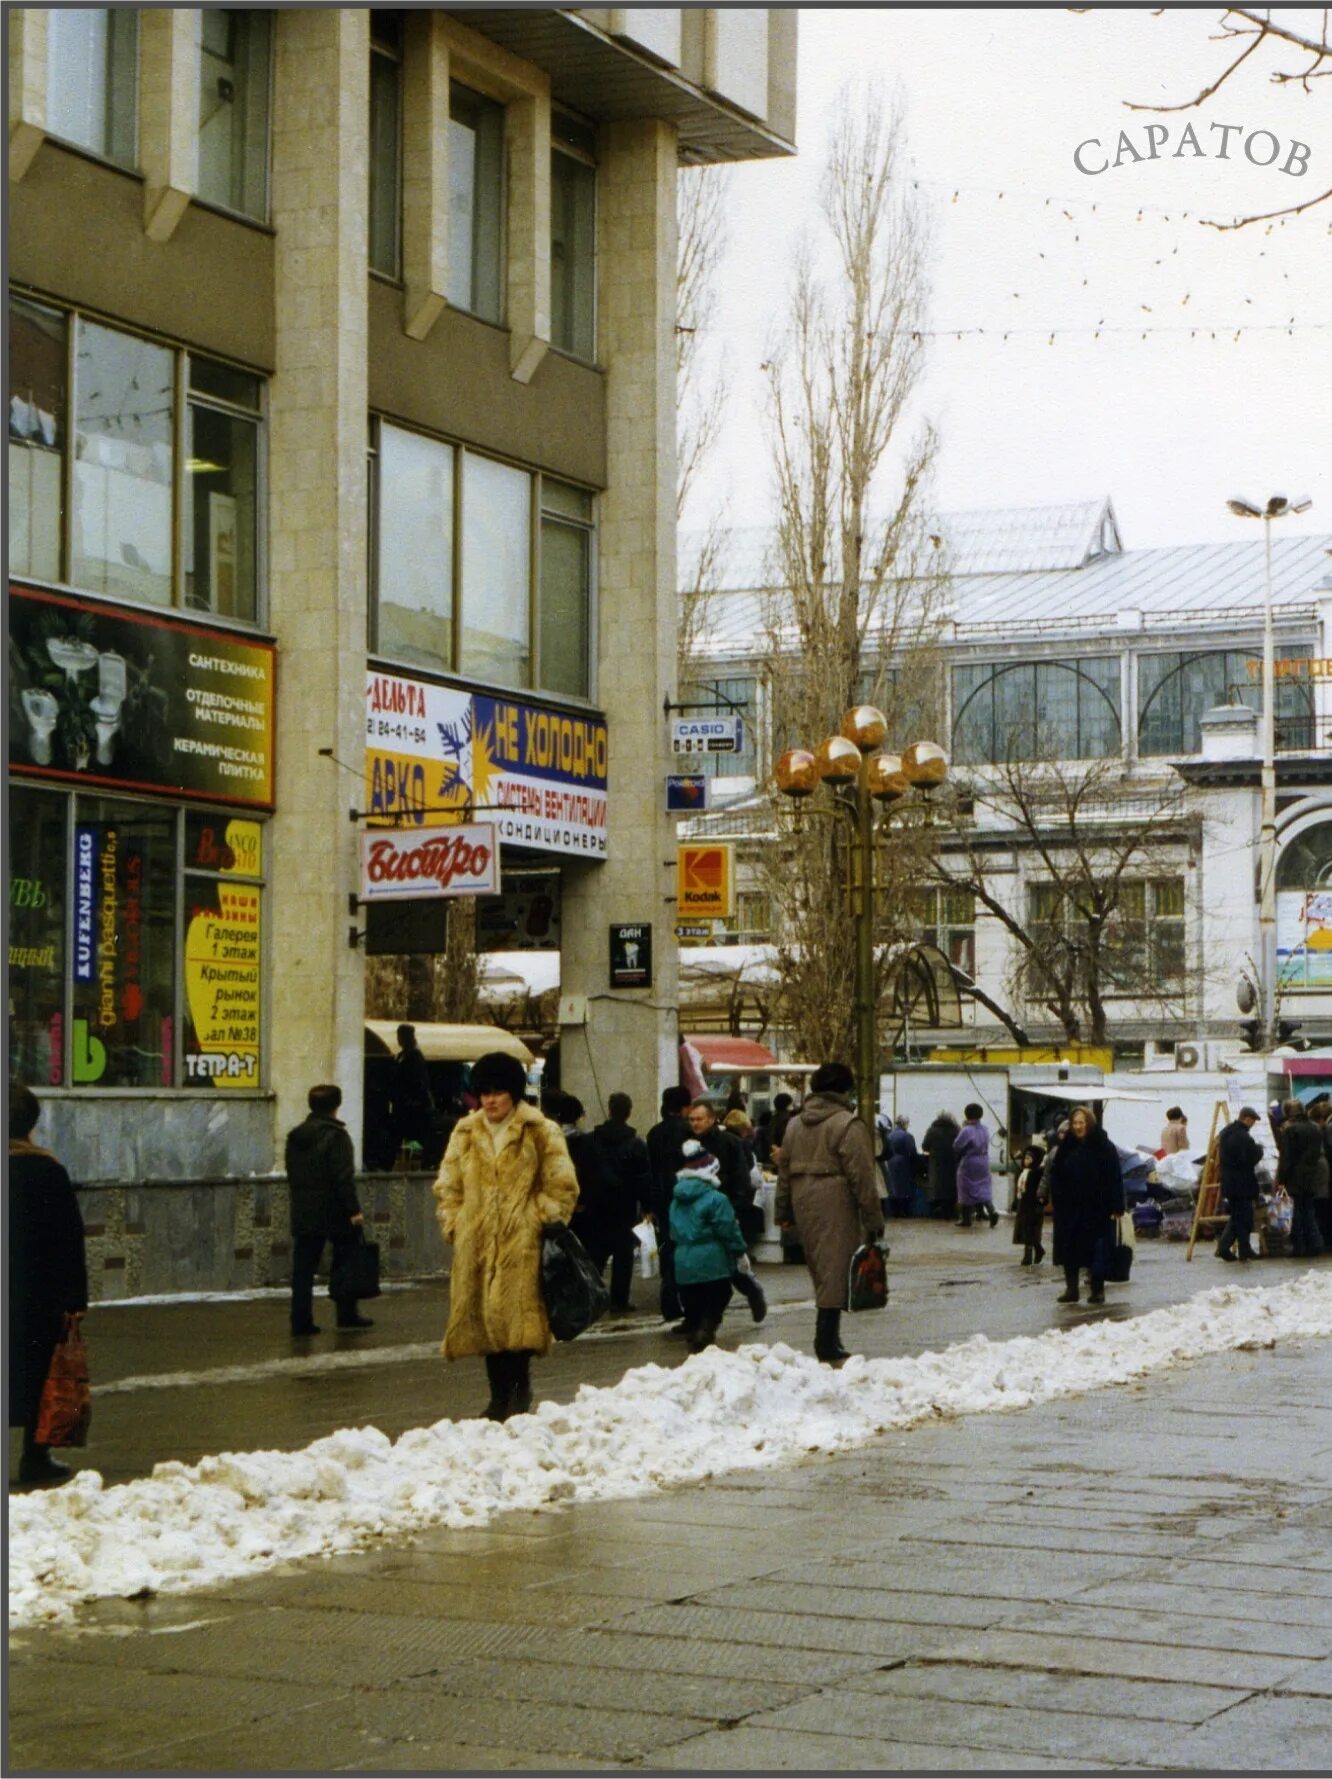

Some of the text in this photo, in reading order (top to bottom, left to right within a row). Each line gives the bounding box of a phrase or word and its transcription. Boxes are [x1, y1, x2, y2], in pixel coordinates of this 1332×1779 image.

[188, 653, 265, 680] САНТЕХНИКА
[186, 688, 264, 716] ОТДЕЛОЧНЫЕ
[195, 707, 264, 730] МАТЕРИАЛЫ
[679, 724, 724, 735] CASIO
[174, 737, 264, 765] КЕРАМИЧЕСКАЯ
[495, 703, 607, 779] НЕ ХОЛОДНО
[219, 762, 264, 780] ПЛИТКА
[371, 756, 425, 825] АРКО
[367, 836, 492, 889] Бистро
[685, 892, 722, 902] Kodak
[205, 923, 257, 944] Галерея
[222, 947, 257, 960] этаж
[200, 964, 257, 984] Крытый
[215, 988, 257, 1004] рынок
[211, 1006, 257, 1022] 2 этаж
[186, 1053, 257, 1077] ТЕТРА-Т
